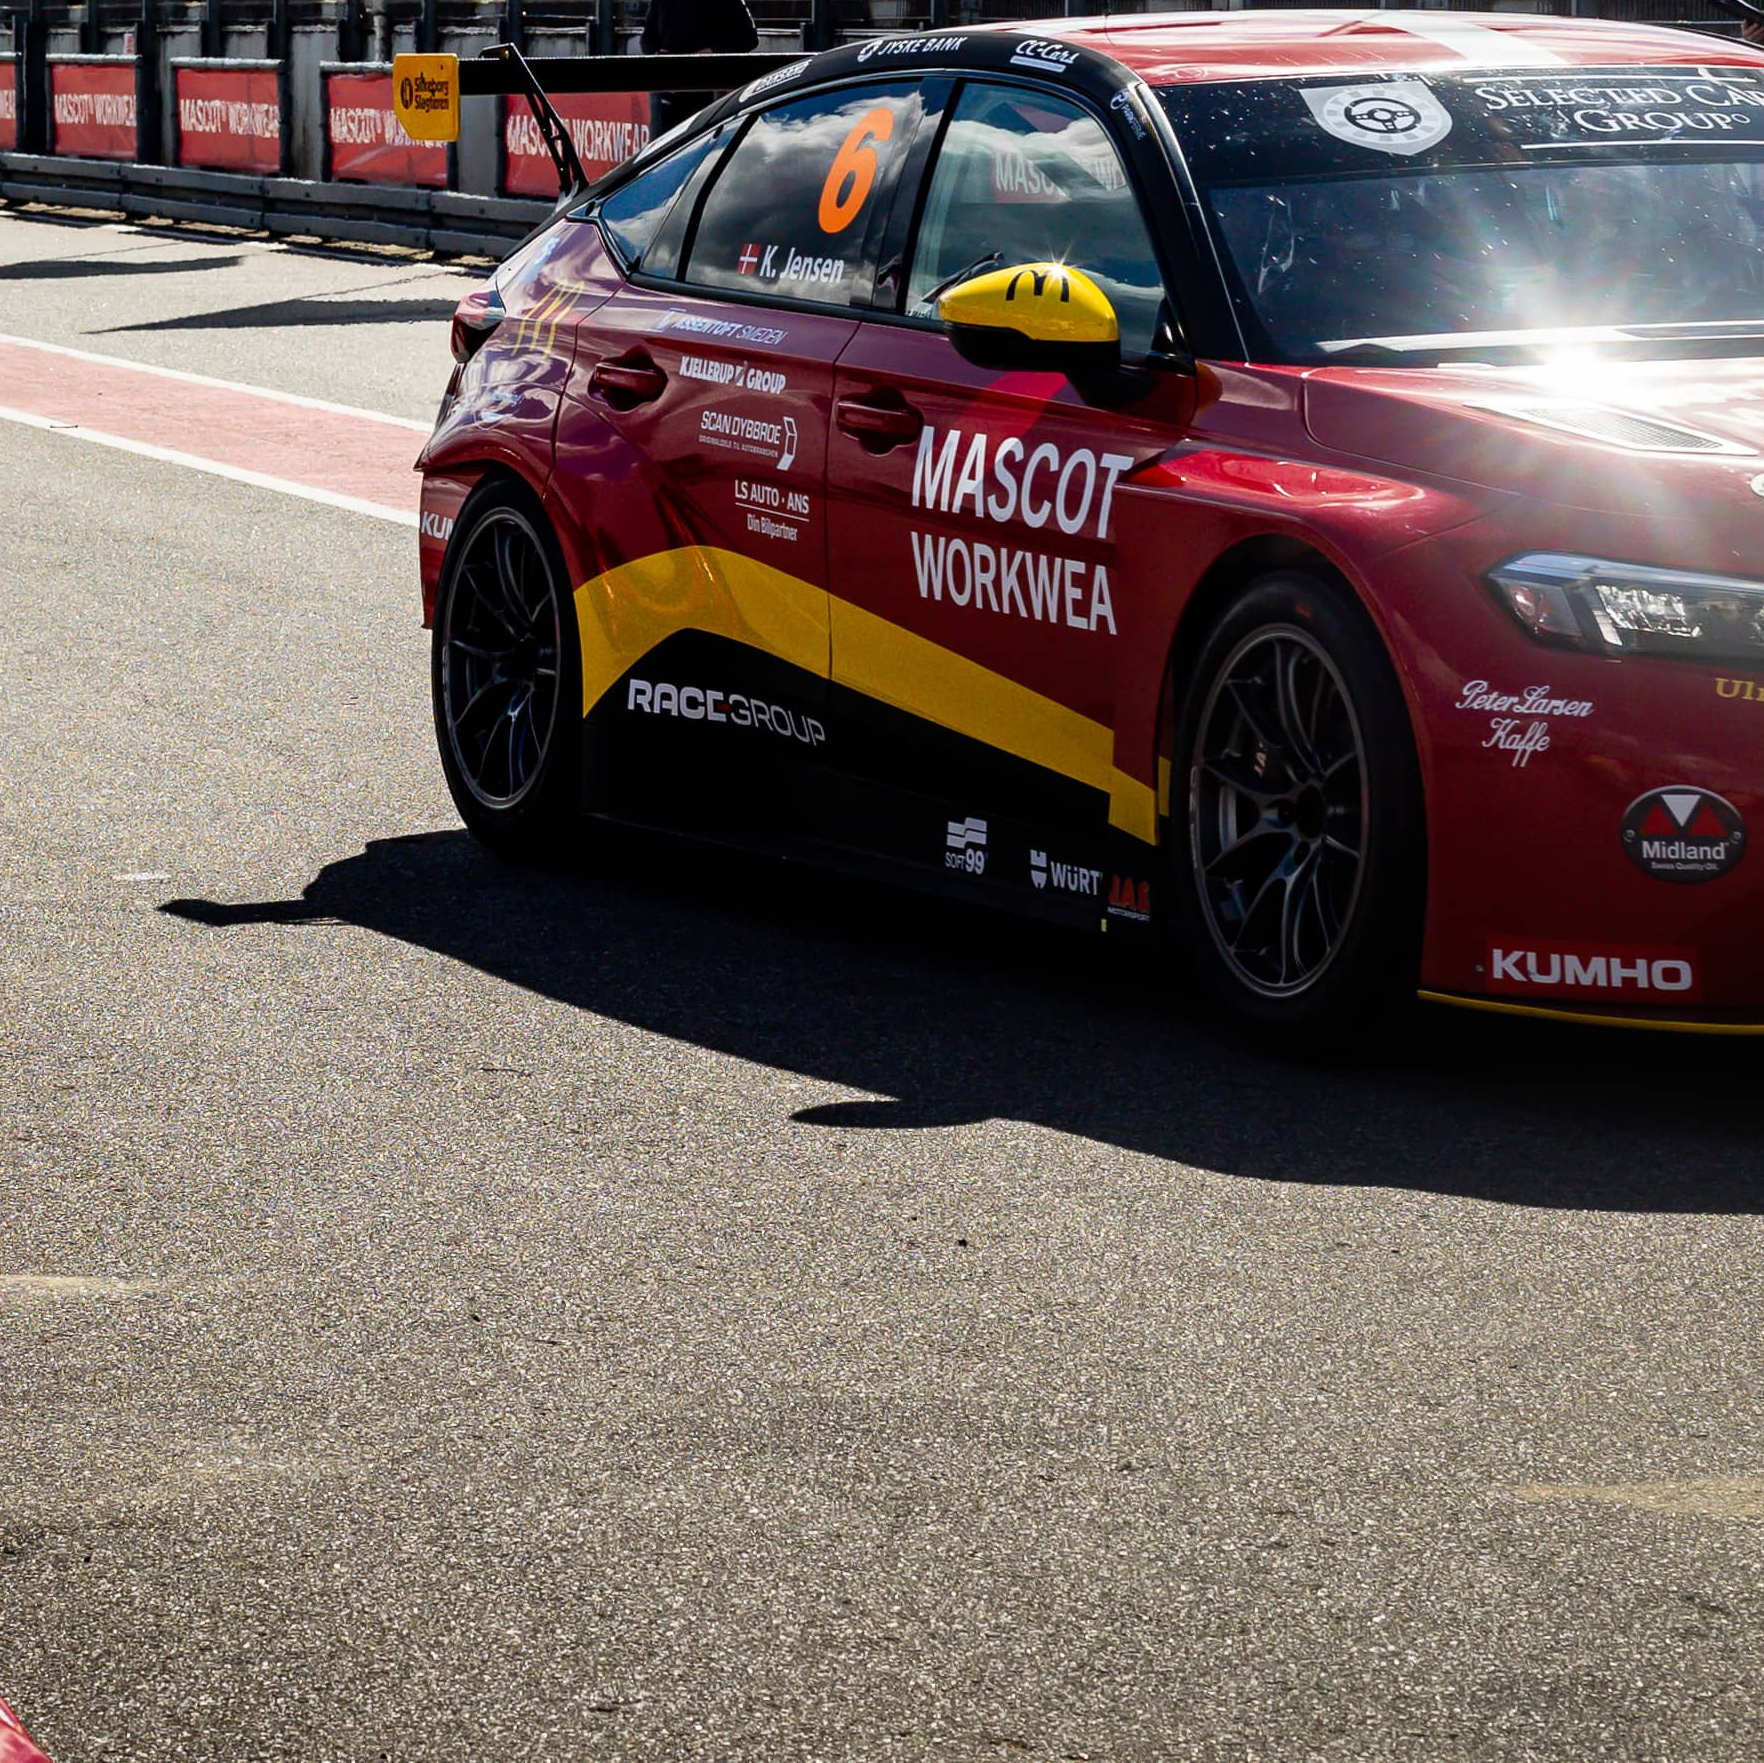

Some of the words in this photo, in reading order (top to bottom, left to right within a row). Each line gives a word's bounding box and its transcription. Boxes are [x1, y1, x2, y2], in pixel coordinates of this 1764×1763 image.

[878, 38, 922, 57] JYSKE
[922, 36, 968, 53] BANK
[818, 104, 893, 235] 6
[759, 244, 778, 278] K.
[780, 246, 845, 284] Jensen
[679, 355, 735, 385] KJELLERUP
[745, 367, 787, 395] GROUP
[735, 479, 748, 500] LS
[750, 483, 780, 507] AUTO
[787, 492, 810, 515] ANS
[911, 425, 1134, 539] MASCOT
[1455, 679, 1519, 711] Peter
[1513, 685, 1595, 718] Larsen
[1481, 717, 1550, 768] Kaffe
[1641, 840, 1726, 860] Midland
[1492, 948, 1693, 991] KUMHO
